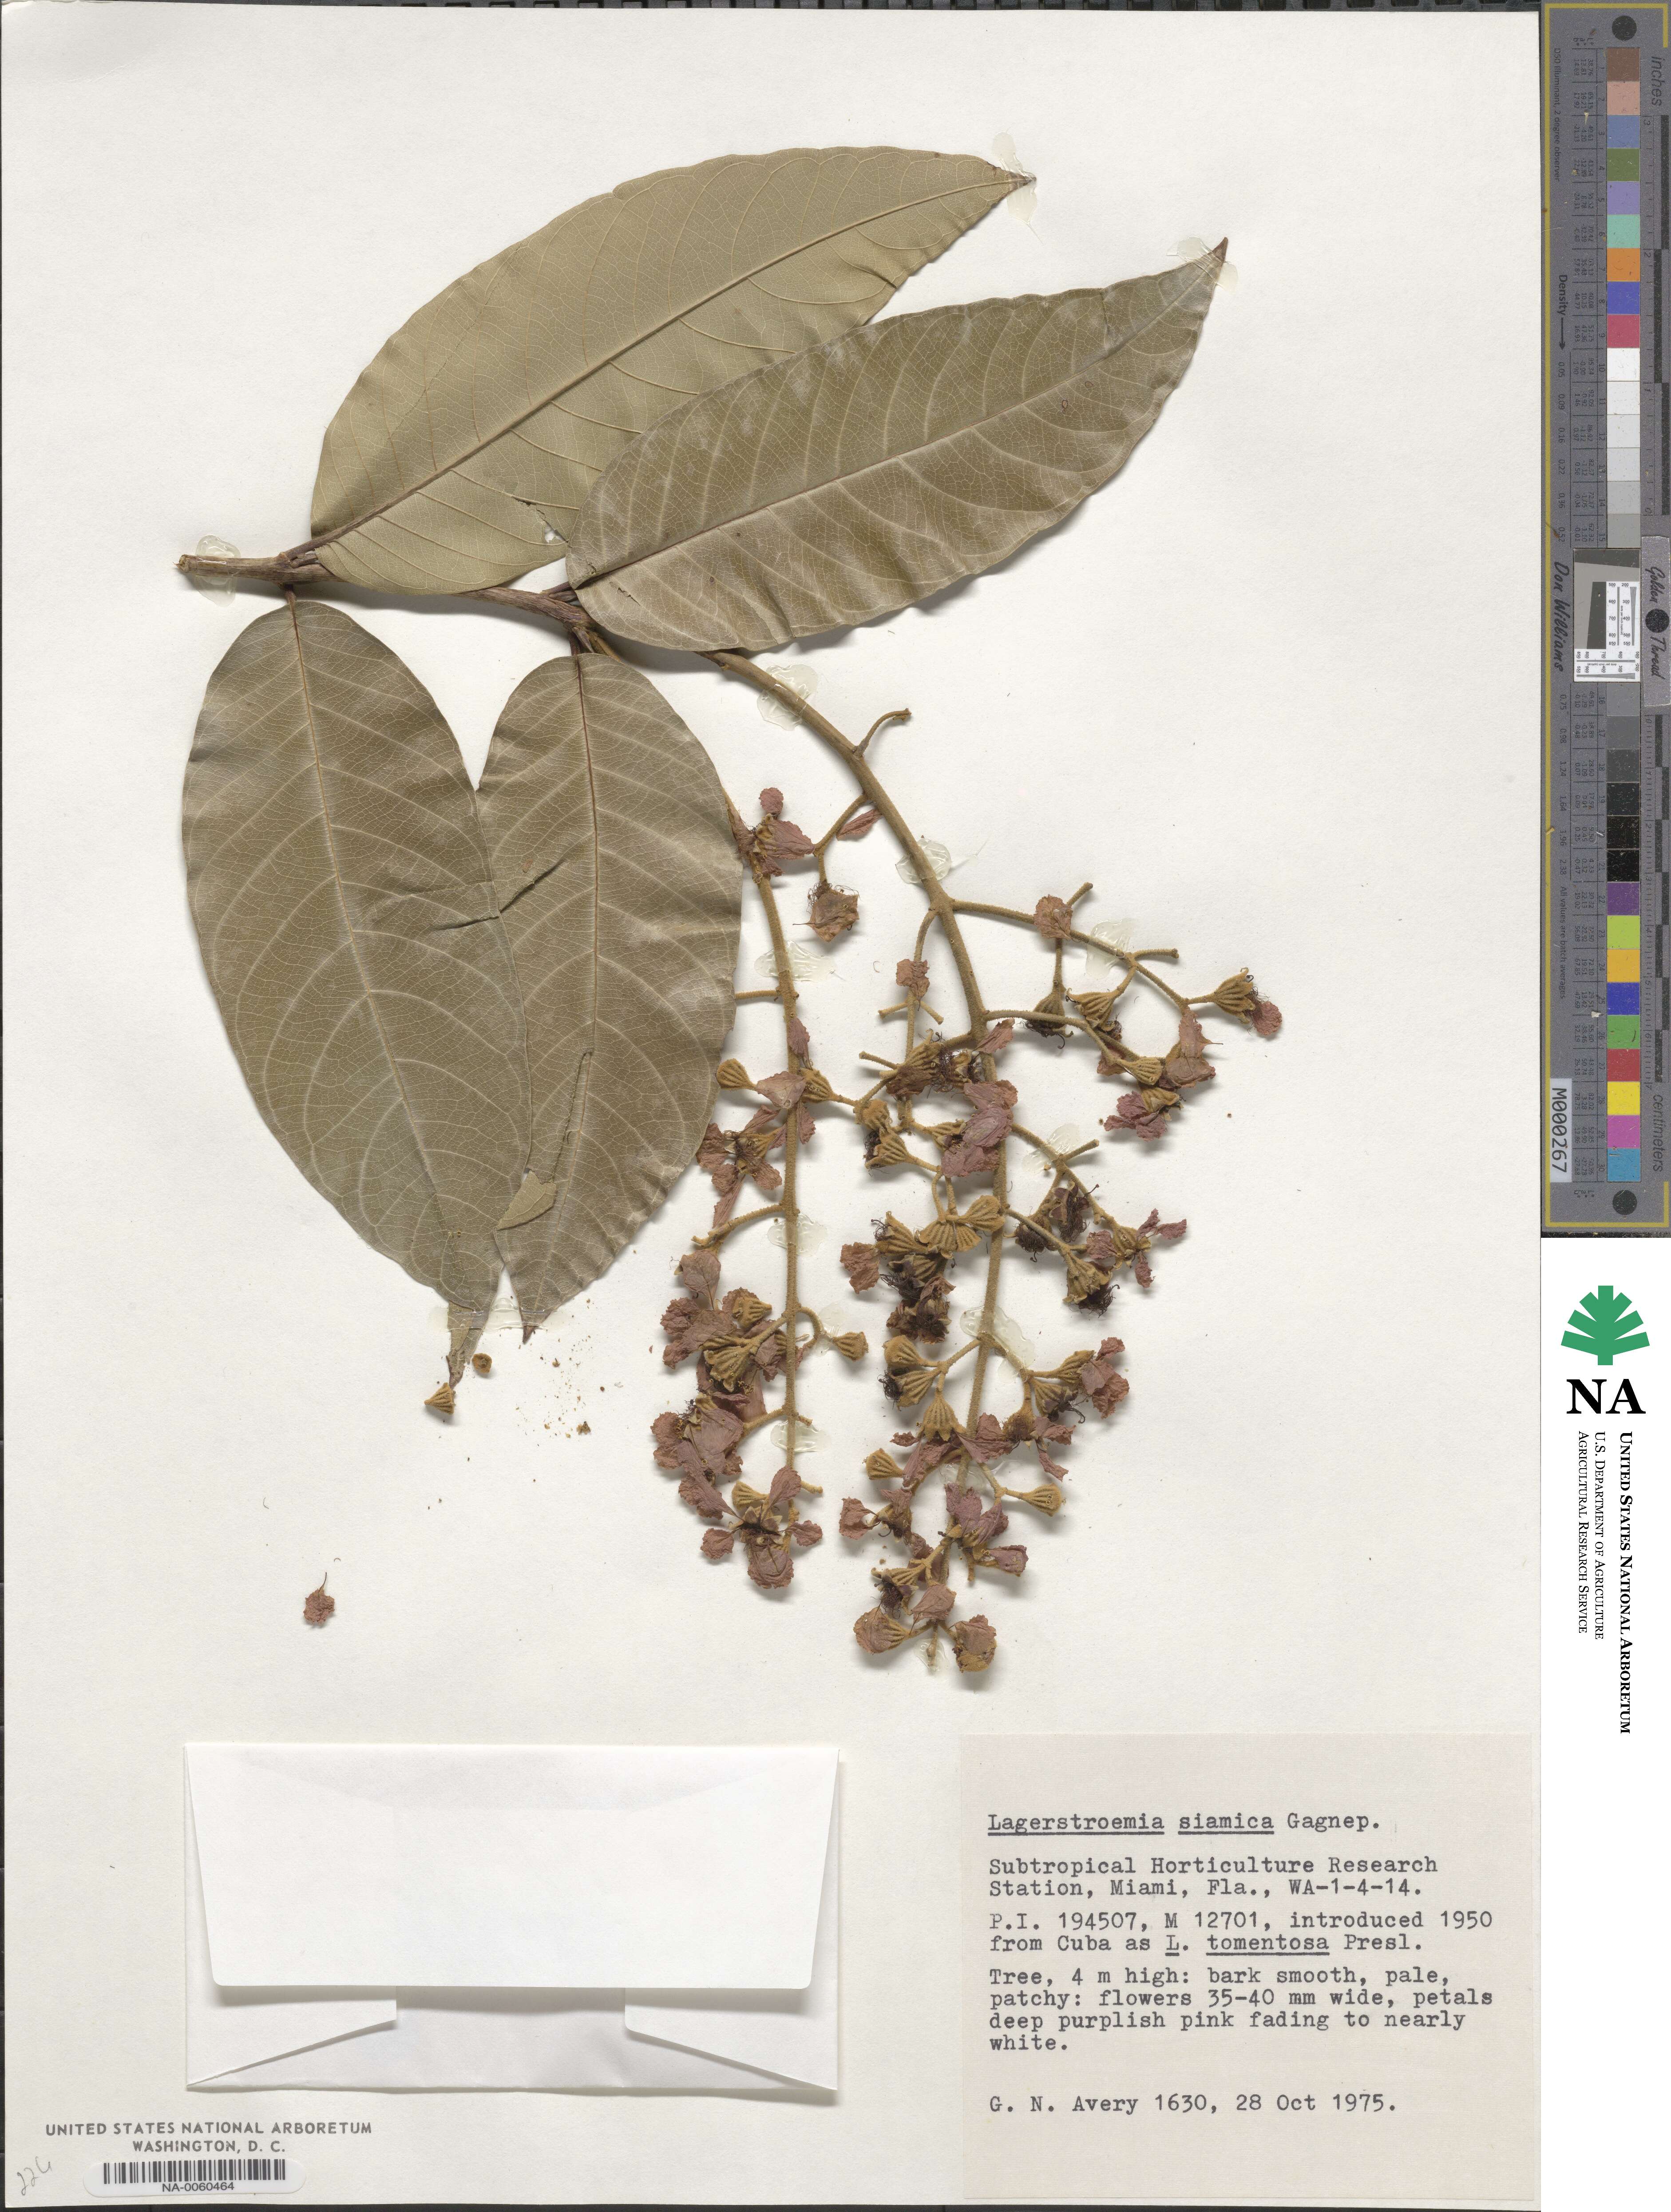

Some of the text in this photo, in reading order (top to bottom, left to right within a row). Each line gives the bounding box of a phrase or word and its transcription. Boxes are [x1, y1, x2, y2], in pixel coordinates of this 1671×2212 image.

[1651, 56, 1665, 106] inches
[1552, 117, 1561, 144] degree
[1556, 275, 1568, 315] Density
[1554, 561, 1571, 672] Don Williams
[1645, 567, 1666, 680] Golden Thread
[1557, 965, 1566, 999] averages
[1551, 1087, 1567, 1173] M000267
[1652, 1094, 1666, 1172] centimeters
[988, 1813, 1378, 1836] Lagerstroemia siamica Gagnep.
[990, 1856, 1437, 1877] Subtropical Horticulture Research
[990, 1878, 1420, 1898] Station, Miami, Fla., WA-1-4-14.
[990, 1911, 1492, 1932] P.I. 194507, M 12701, introduced 1950
[990, 1934, 1421, 1951] from Cuba as L. tomentosa Presl.
[990, 1967, 1448, 1987] Tree, 4 m high: bark smooth, pale,
[990, 1988, 1492, 2010] patchy: flowers 35-40 mm wide, petals
[990, 2010, 1465, 2032] deep purplish pink fading to nearly
[990, 2034, 1067, 2050] white.
[990, 2094, 1394, 2115] G. N. Avery 1630, 28 Oct 1975.
[46, 2122, 371, 2136] UNITED STATES NATIONAL ARBORETUM
[133, 2141, 285, 2153] WASHINGTON, D. C.
[162, 2182, 234, 2192] NA-0060464
